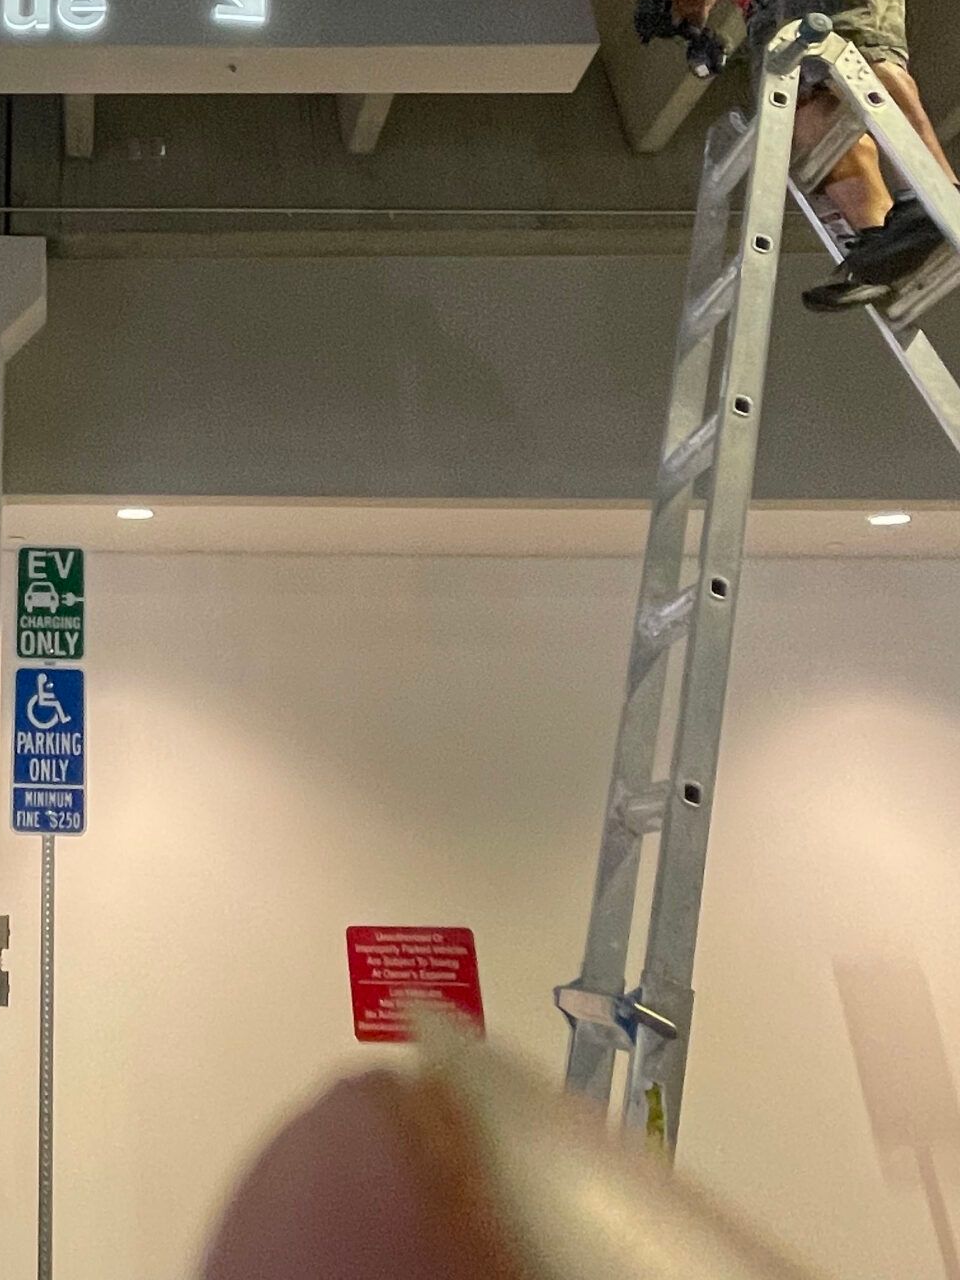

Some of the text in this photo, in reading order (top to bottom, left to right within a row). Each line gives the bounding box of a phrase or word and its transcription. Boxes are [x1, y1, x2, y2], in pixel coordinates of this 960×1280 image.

[28, 551, 74, 579] EV
[20, 615, 81, 629] CHARGING
[20, 630, 80, 656] ONLY
[17, 732, 82, 755] PARKING
[29, 758, 69, 782] ONLY
[25, 791, 73, 807] MINIMUM
[17, 810, 81, 829] FINE $250
